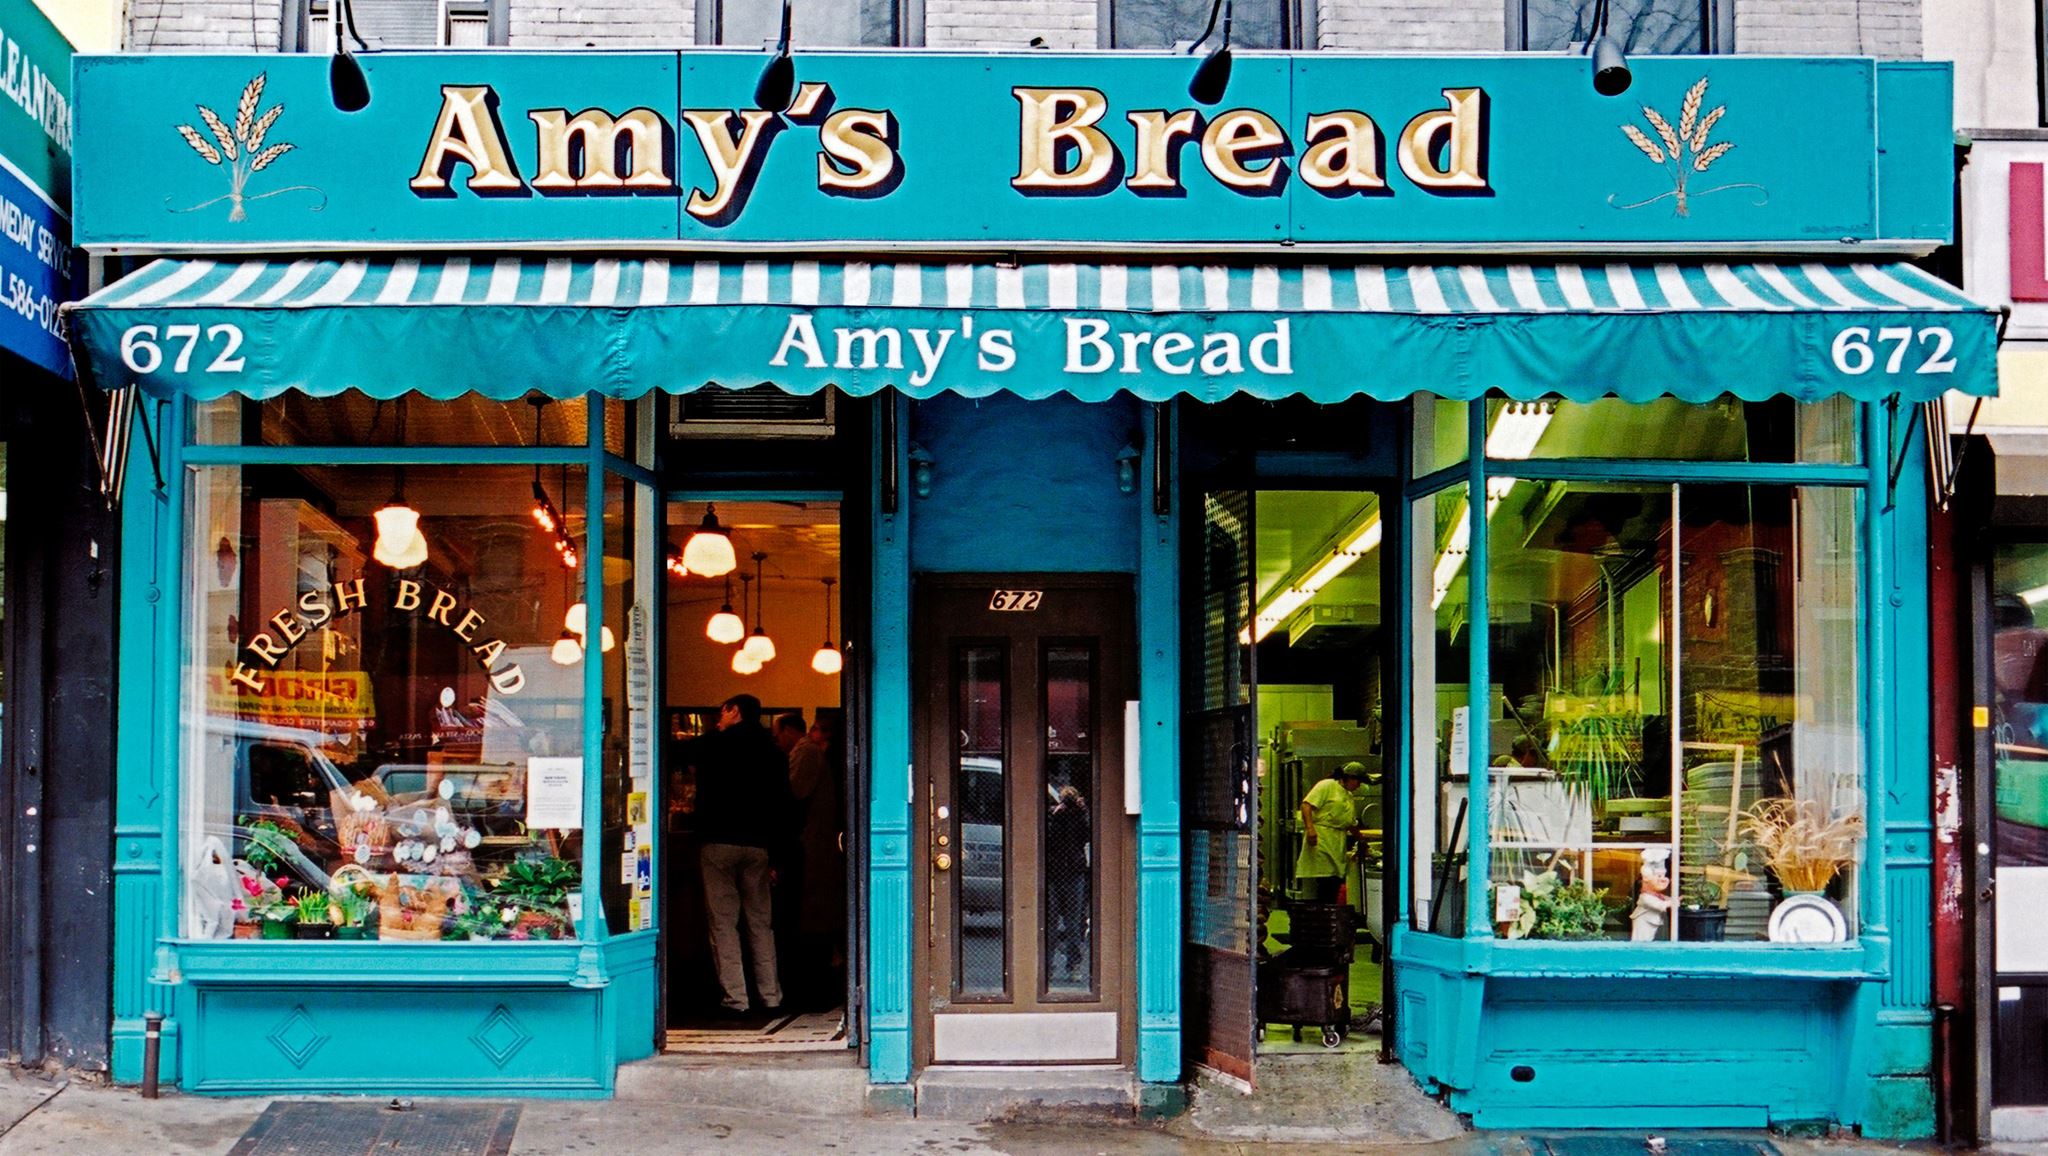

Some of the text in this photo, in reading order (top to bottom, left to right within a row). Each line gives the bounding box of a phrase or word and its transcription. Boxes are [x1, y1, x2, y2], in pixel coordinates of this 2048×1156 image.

[409, 82, 1496, 228] Amy's Bread
[121, 324, 246, 374] 672
[769, 313, 1294, 387] Amy's Bread
[1831, 326, 1957, 375] 672
[992, 590, 1039, 610] 672
[231, 578, 526, 695] FRESH BREAD
